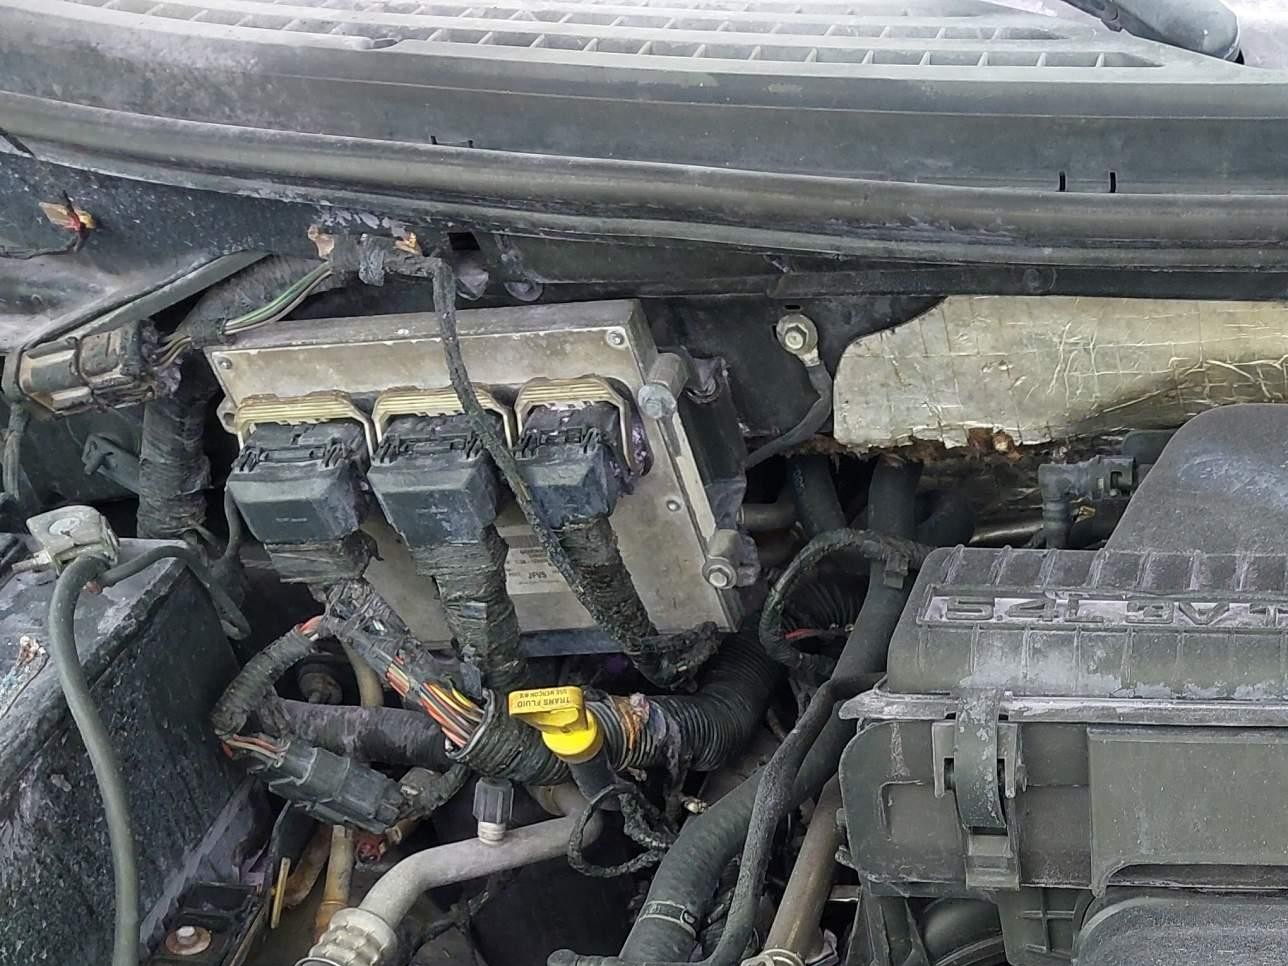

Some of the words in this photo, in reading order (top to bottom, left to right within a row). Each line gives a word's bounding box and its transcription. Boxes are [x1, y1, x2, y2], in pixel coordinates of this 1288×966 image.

[1125, 601, 1231, 626] 3V
[516, 699, 541, 708] FLUID
[543, 696, 569, 706] TRANS
